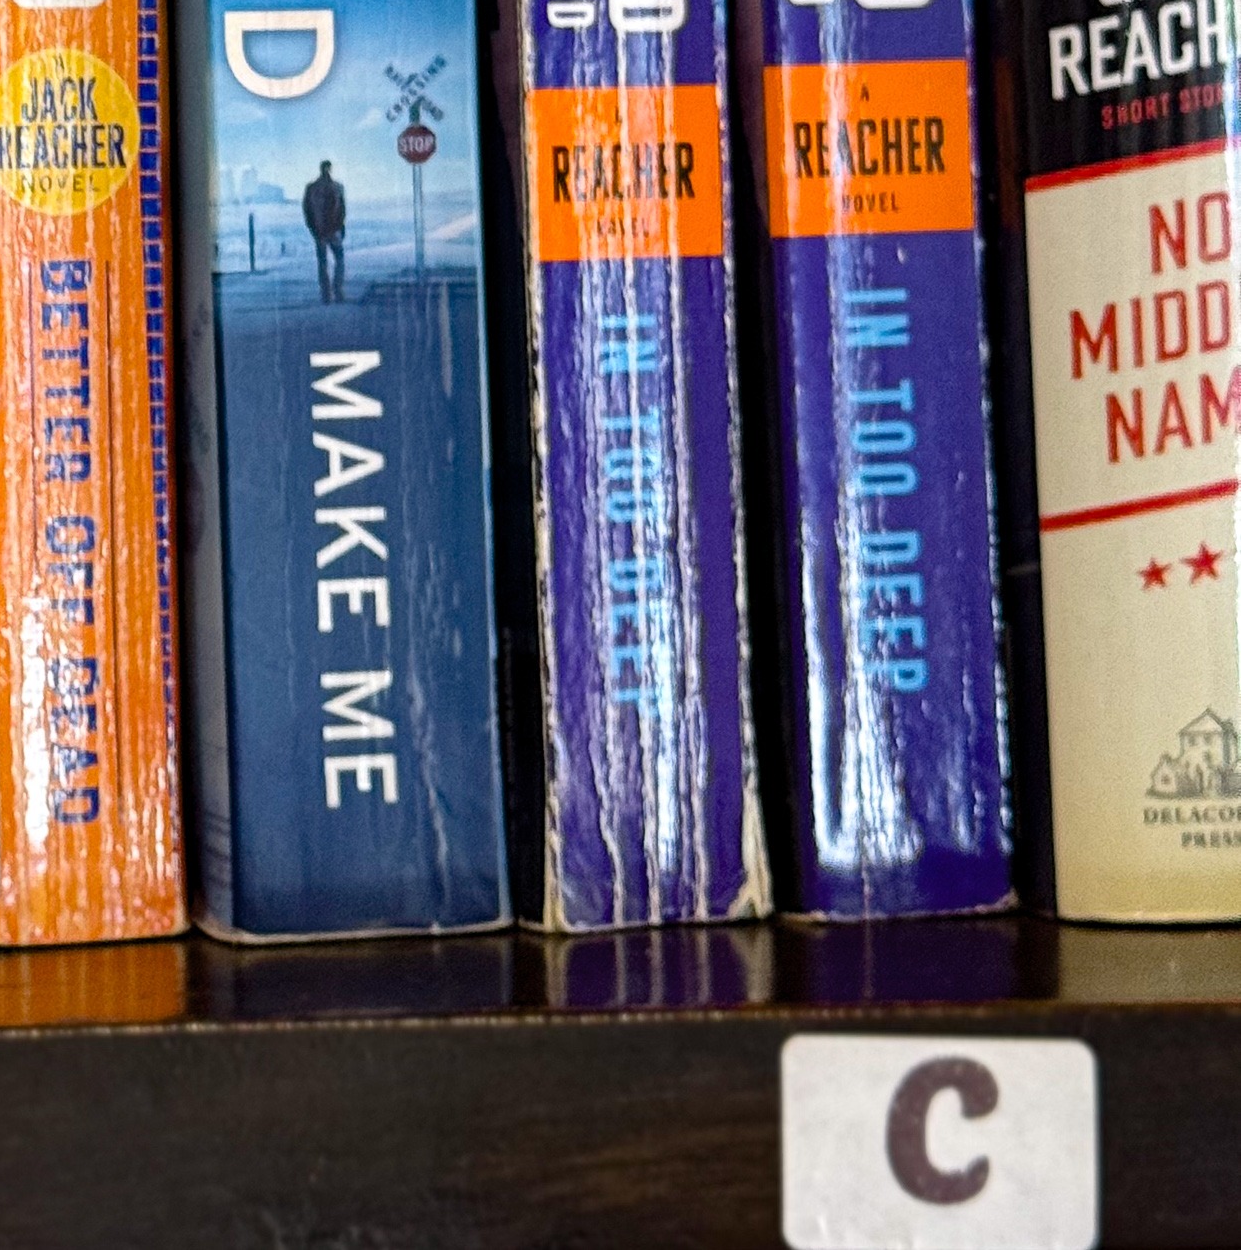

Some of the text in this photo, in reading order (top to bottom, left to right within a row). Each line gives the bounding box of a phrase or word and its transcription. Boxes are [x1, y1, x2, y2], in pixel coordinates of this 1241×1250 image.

[21, 66, 98, 122] JACK
[1101, 92, 1172, 131] SHORT
[21, 173, 101, 193] NOVEL
[399, 136, 434, 153] STOP
[552, 142, 696, 203] REACHER
[794, 116, 946, 179] REACHER
[1149, 190, 1230, 276] NO
[598, 313, 657, 376] IN
[1069, 280, 1231, 381] MIDD
[1104, 364, 1241, 465] NAM
[602, 405, 661, 525] TOO
[842, 287, 928, 693] IN TOO DEEP
[39, 258, 101, 826] BETTER OFF DEAD
[310, 350, 399, 809] MAKE ME
[888, 1058, 999, 1206] C
